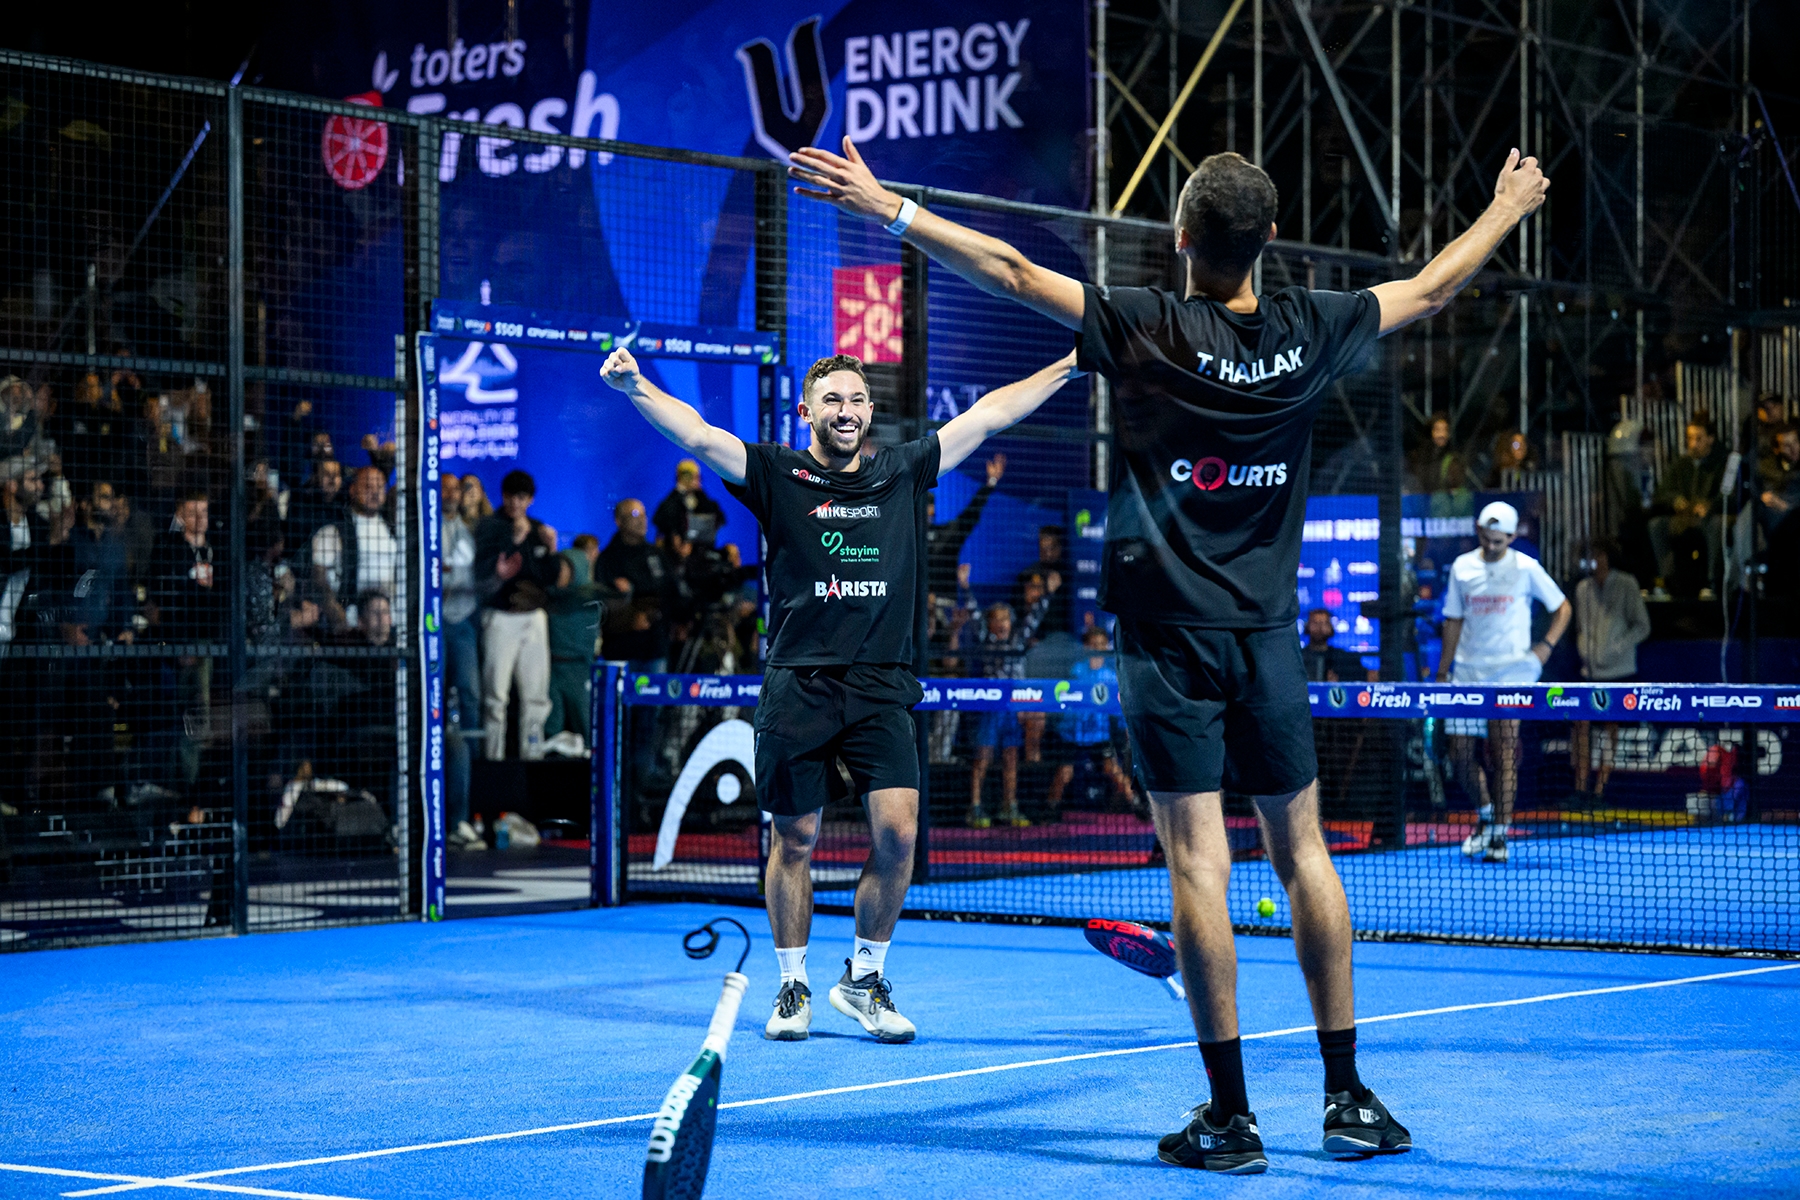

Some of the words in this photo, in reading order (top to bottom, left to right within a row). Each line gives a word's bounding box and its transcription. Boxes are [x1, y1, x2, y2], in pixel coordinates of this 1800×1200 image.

[410, 39, 526, 87] toters
[845, 18, 1031, 83] ENERGY
[845, 72, 1024, 144] DRINK
[398, 70, 620, 187] Fresh
[495, 322, 523, 338] BOSS
[1197, 351, 1213, 375] T.
[1219, 346, 1303, 383] HALLAK
[427, 436, 438, 481] BOSS
[1170, 456, 1287, 490] COURTS
[816, 504, 879, 518] MIKESPORT
[840, 545, 879, 558] stayinn
[815, 574, 887, 602] BARISTA
[700, 683, 732, 699] Fresh
[738, 685, 762, 696] HE
[947, 688, 1002, 701] HEAD
[1011, 687, 1043, 701] mtv
[1371, 691, 1411, 707] Fresh
[1419, 693, 1484, 705] HEAD
[1496, 692, 1533, 705] mtv
[1638, 694, 1682, 711] Fresh
[1691, 695, 1762, 708] HEAD
[1777, 695, 1800, 708] mt
[431, 725, 441, 771] BOSS
[1088, 918, 1154, 940] HEAD
